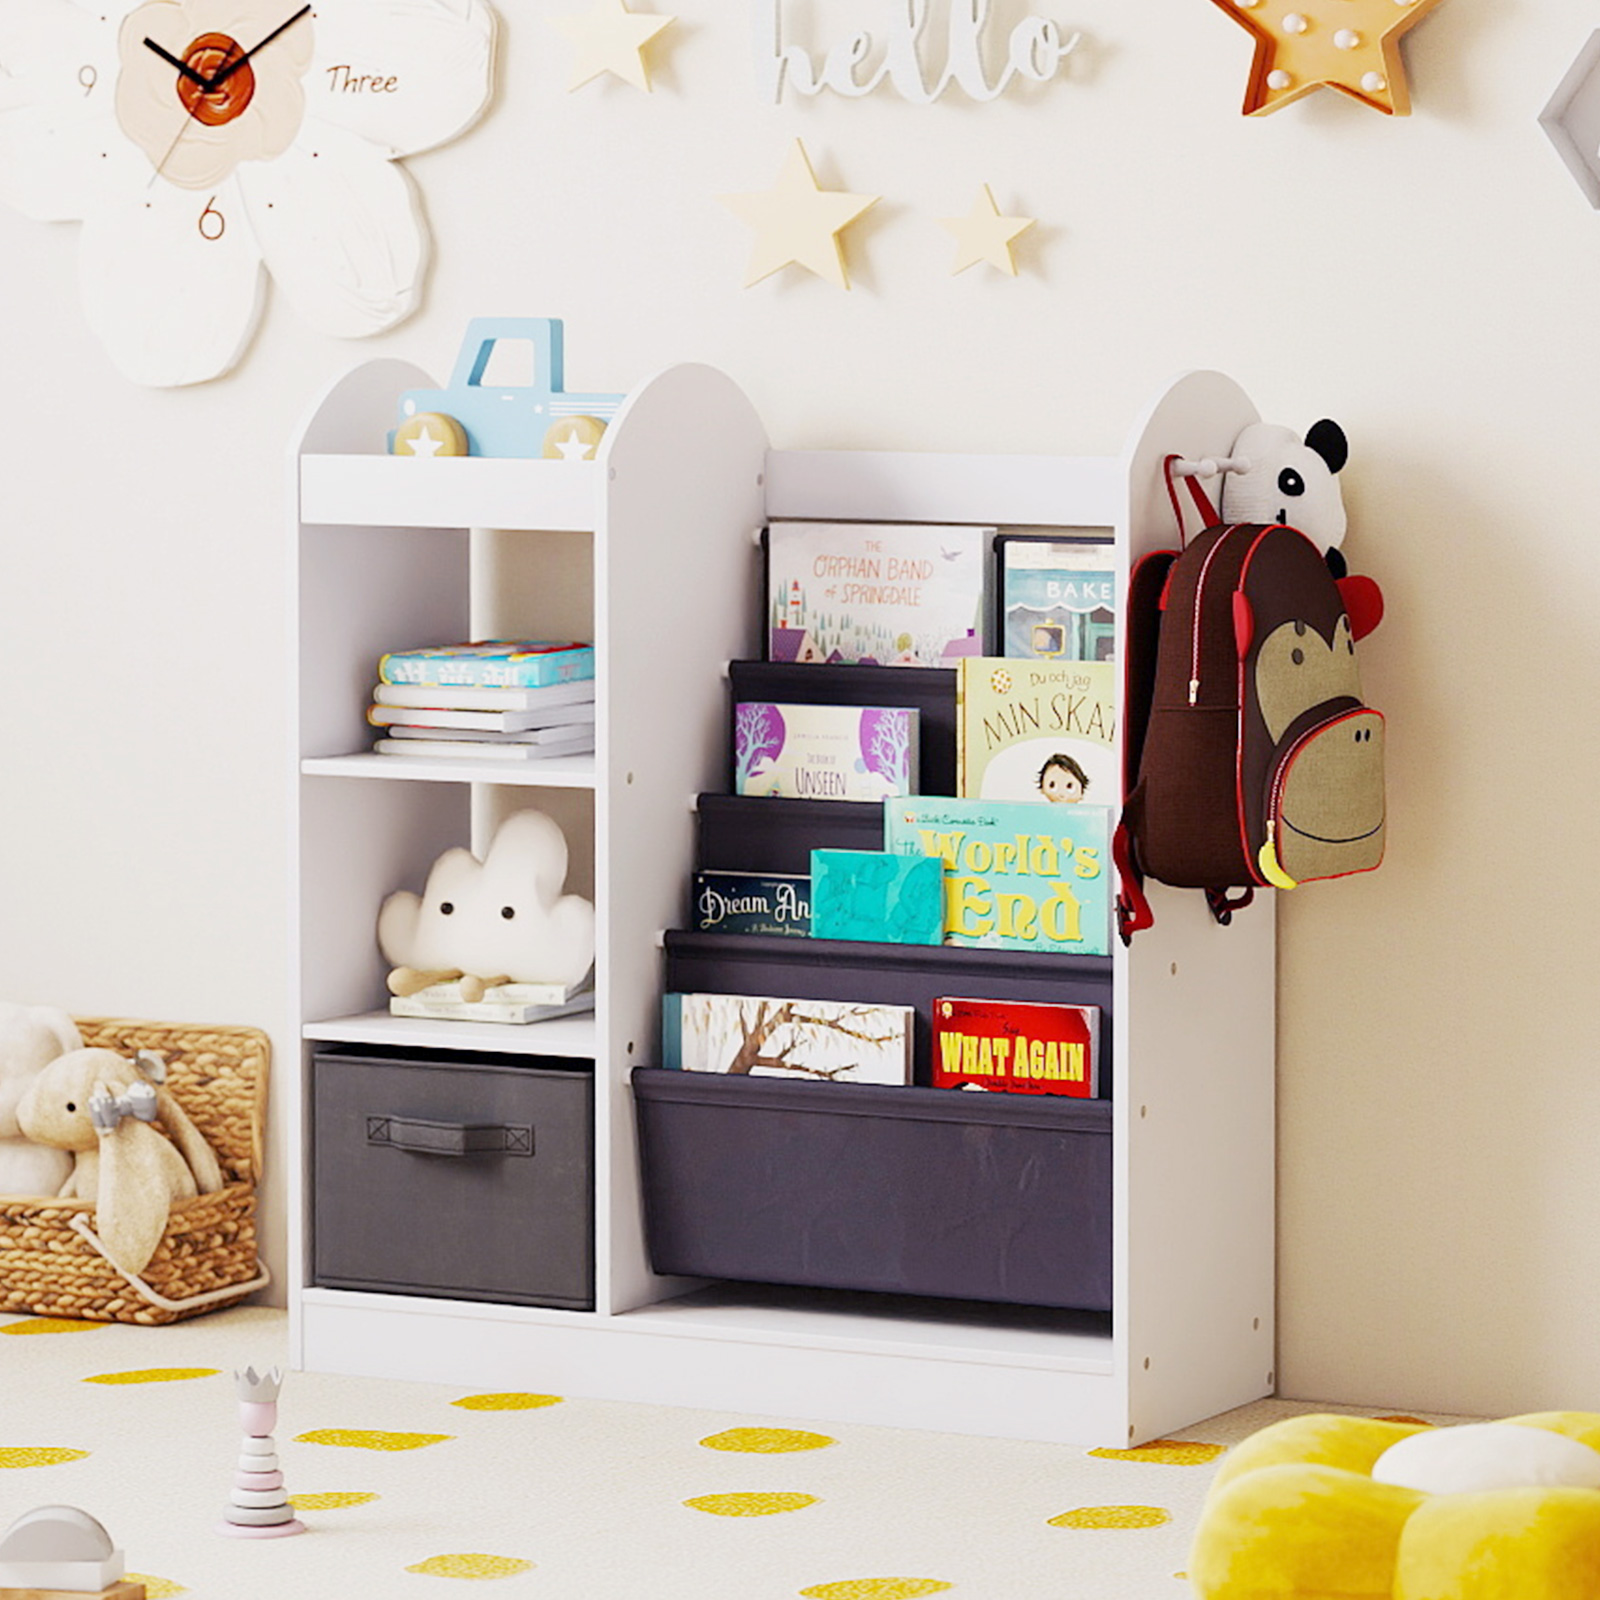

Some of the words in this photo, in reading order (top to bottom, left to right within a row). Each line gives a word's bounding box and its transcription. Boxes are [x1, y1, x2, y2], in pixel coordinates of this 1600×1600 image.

[751, 0, 1080, 104] hello
[78, 65, 97, 98] 9
[326, 65, 398, 93] Three
[198, 195, 225, 240] 6
[865, 540, 882, 552] THE
[813, 554, 880, 578] ORPHAN
[887, 557, 934, 580] BAND
[841, 583, 922, 607] SPRINGDALE
[1046, 581, 1112, 600] BAKE
[1029, 672, 1047, 687] Du
[1049, 670, 1069, 683] och
[1065, 674, 1092, 692] jag
[983, 697, 1040, 750] MIN
[795, 767, 847, 796] UNSEEN
[917, 829, 1102, 879] World's
[699, 886, 771, 930] Dream
[943, 876, 1083, 943] End
[940, 1031, 1010, 1076] WHAT
[1012, 1036, 1084, 1082] AGAIN
